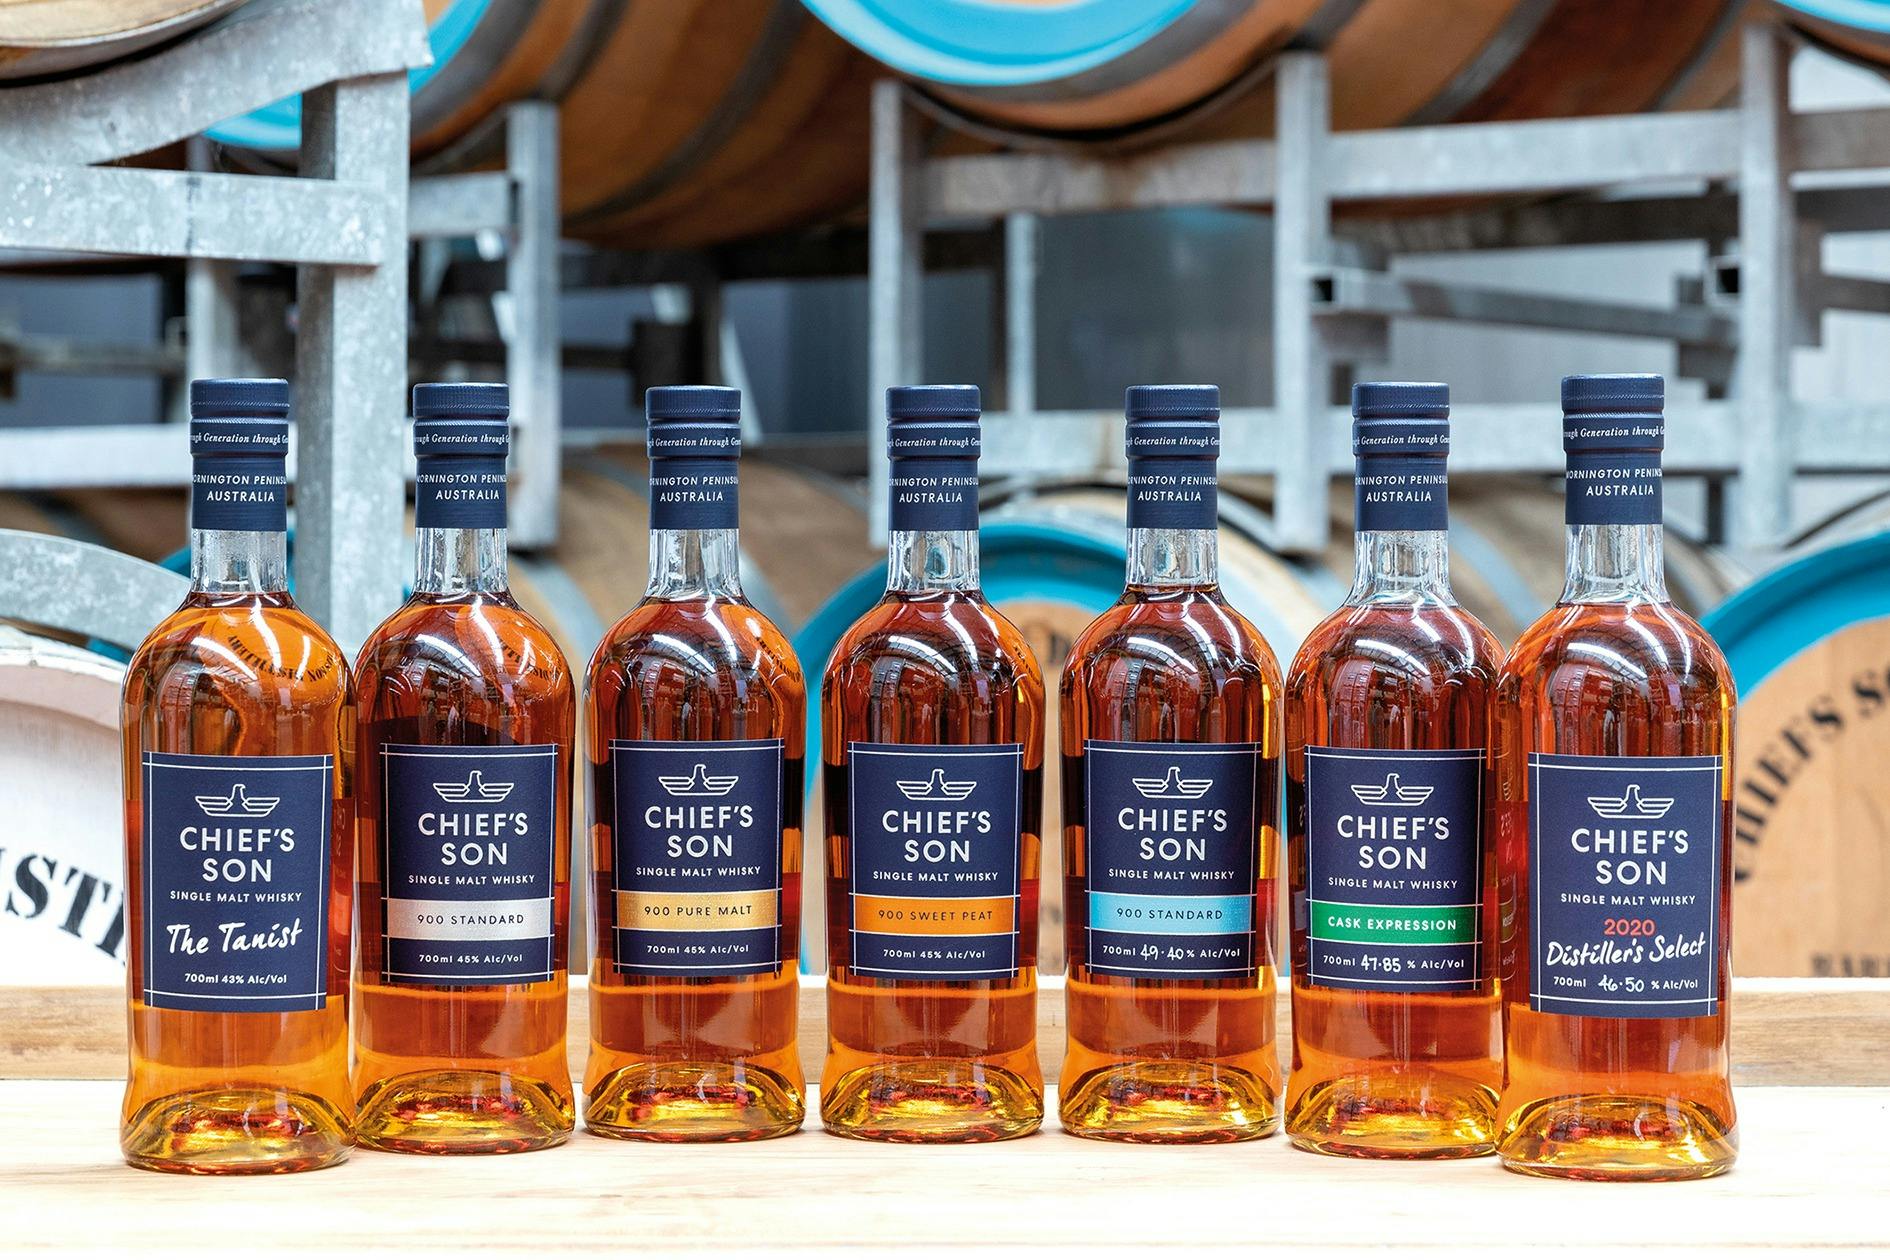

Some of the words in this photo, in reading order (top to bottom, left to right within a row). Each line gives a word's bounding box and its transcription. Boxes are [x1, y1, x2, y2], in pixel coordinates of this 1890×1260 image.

[1581, 427, 1629, 437] Generation
[1632, 426, 1659, 437] through
[204, 433, 249, 442] Generation
[253, 434, 280, 445] through
[432, 434, 478, 442] Generation
[481, 434, 505, 445] through
[655, 438, 696, 446] Generation
[700, 437, 729, 448] through
[895, 438, 936, 447] Generation
[940, 437, 969, 448] through
[1134, 437, 1176, 445] Generation
[1180, 436, 1208, 447] through
[1361, 436, 1404, 445] Generation
[1408, 435, 1437, 445] through
[207, 491, 274, 501] AUSTRALIA
[436, 490, 499, 500] AUSTRALIA
[1138, 491, 1201, 501] AUSTRALIA
[1586, 485, 1654, 496] AUSTRALIA
[660, 492, 723, 501] AUSTRALIA
[899, 493, 962, 503] AUSTRALIA
[1366, 491, 1431, 502] AUSTRALIA
[645, 805, 753, 828] CHIEF'S
[883, 810, 990, 833] CHIEF'S
[1119, 808, 1226, 831] CHIEF'S
[419, 813, 528, 836] CHIEF'S
[1338, 815, 1449, 839] CHIEF'S
[180, 827, 294, 851] CHIEF'S
[1572, 829, 1688, 854] CHIEF'S
[668, 835, 732, 857] SON
[904, 840, 969, 862] SON
[1140, 838, 1205, 860] SON
[442, 843, 507, 865] SON
[1359, 846, 1426, 869] SON
[203, 858, 271, 882] SON
[637, 867, 676, 876] SINGLE
[682, 868, 712, 876] MALT
[718, 866, 760, 876] WHISKY
[1109, 869, 1147, 878] SINGLE
[1154, 871, 1184, 879] MALT
[1190, 871, 1234, 879] WHISKY
[1596, 860, 1666, 884] SON
[409, 875, 449, 884] SINGLE
[492, 875, 534, 884] WHISKY
[874, 871, 912, 881] SINGLE
[919, 873, 949, 881] MALT
[955, 872, 998, 881] WHISKY
[1329, 877, 1367, 888] SINGLE
[1373, 880, 1404, 889] MALT
[1410, 881, 1457, 889] WHISKY
[171, 891, 211, 901] SINGLE
[217, 894, 249, 902] MALT
[255, 893, 301, 902] WHISKY
[1561, 893, 1604, 904] SINGLE
[1612, 896, 1644, 905] MALT
[1650, 896, 1695, 905] WHISKY
[645, 906, 669, 916] 900
[677, 907, 710, 916] PURE
[719, 906, 751, 915] MALT
[879, 910, 903, 920] 900
[910, 911, 955, 921] SWEET
[963, 911, 992, 920] PEAT
[1117, 908, 1142, 918] 900
[1149, 910, 1222, 919] STANDARD
[418, 915, 443, 924] 900
[451, 915, 523, 924] STANDARD
[1328, 916, 1360, 928] CASK
[1368, 919, 1455, 930] EXPRESSION
[1605, 919, 1655, 936] 2020
[167, 924, 208, 955] The
[219, 918, 302, 952] Tanist
[711, 945, 748, 953] Alc/Vol
[884, 949, 915, 957] 700ml
[946, 951, 985, 959] Alc/Vol
[1103, 946, 1135, 955] 700ml
[1200, 949, 1239, 958] Alc/Vol
[1547, 938, 1643, 967] Distiller's
[1649, 932, 1706, 962] Select
[484, 954, 522, 963] Alc/Vol
[1324, 955, 1355, 966] 700ml
[1407, 960, 1415, 968] %
[1421, 960, 1463, 969] Alc/Vol
[185, 973, 218, 983] 700ml
[222, 975, 244, 984] 43%
[248, 975, 286, 984] Alc/Vol
[1554, 977, 1586, 987] 700ml
[1651, 981, 1659, 989] %
[1663, 979, 1697, 989] Alc/Vol
